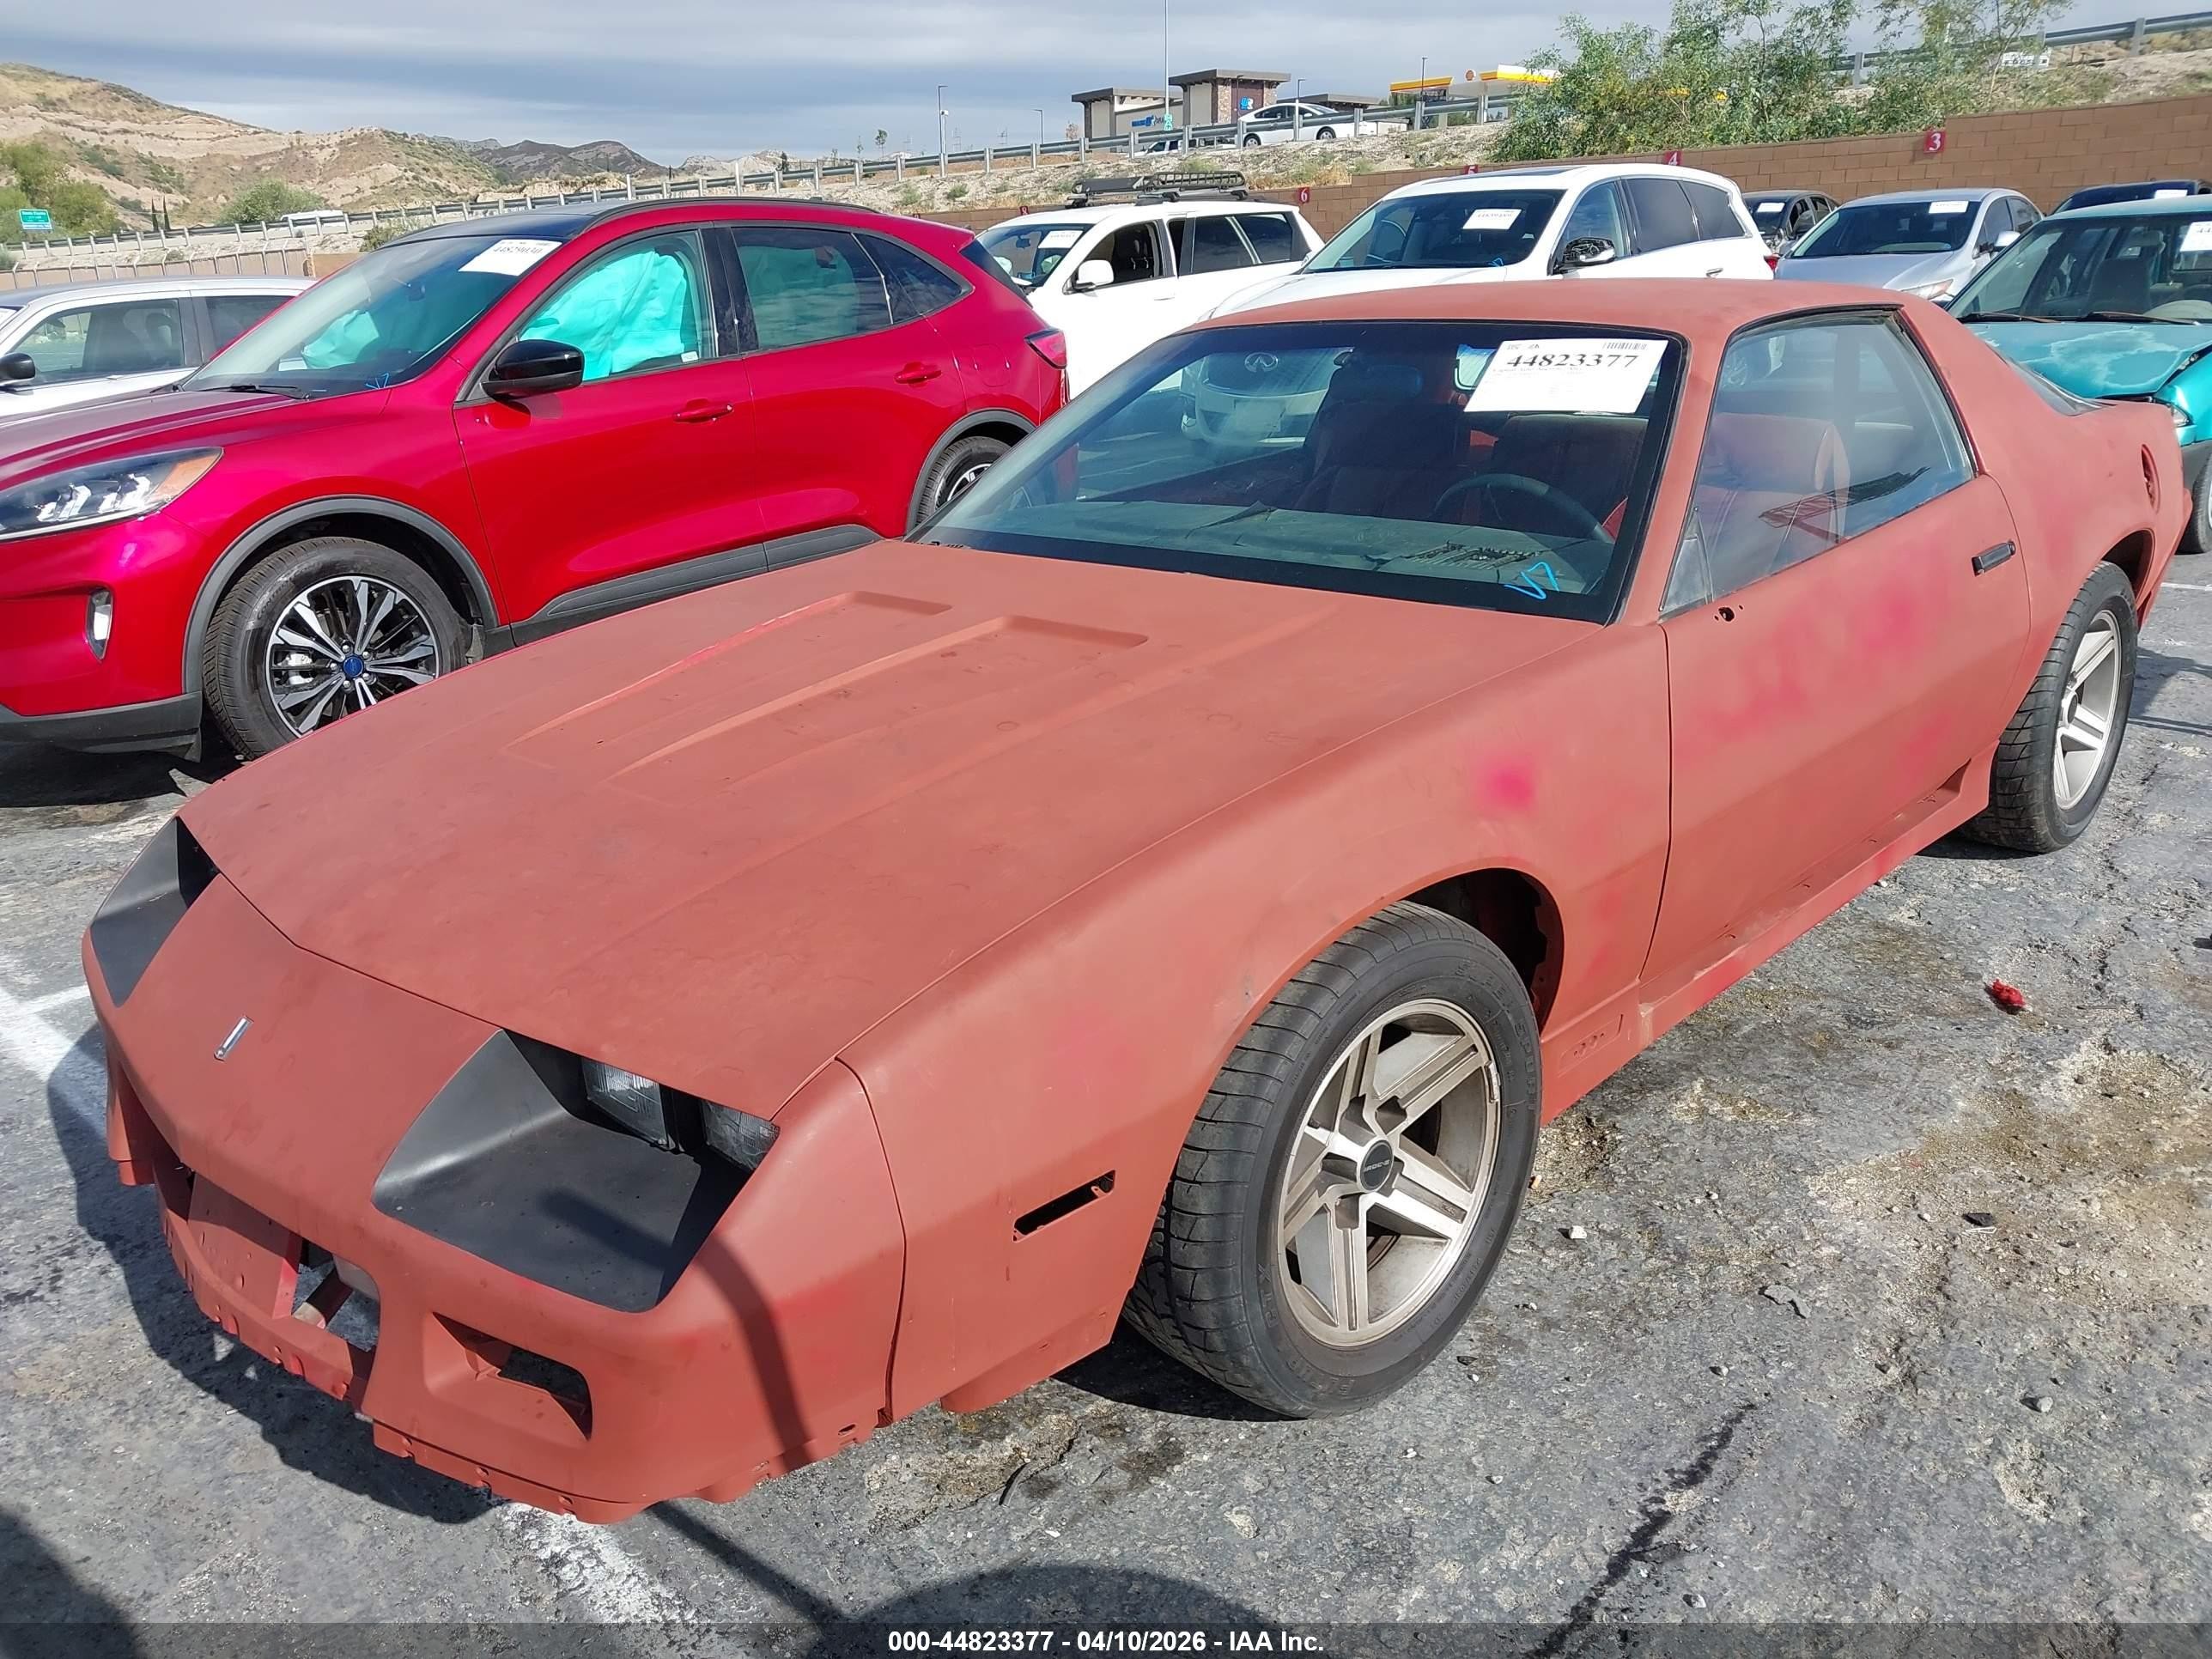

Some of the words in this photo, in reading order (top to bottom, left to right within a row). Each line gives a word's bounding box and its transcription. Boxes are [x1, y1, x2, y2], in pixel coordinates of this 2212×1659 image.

[1929, 132, 1942, 151] 3
[1668, 151, 1678, 165] 4
[1301, 187, 1308, 203] 6
[1507, 353, 1639, 368] 44823377
